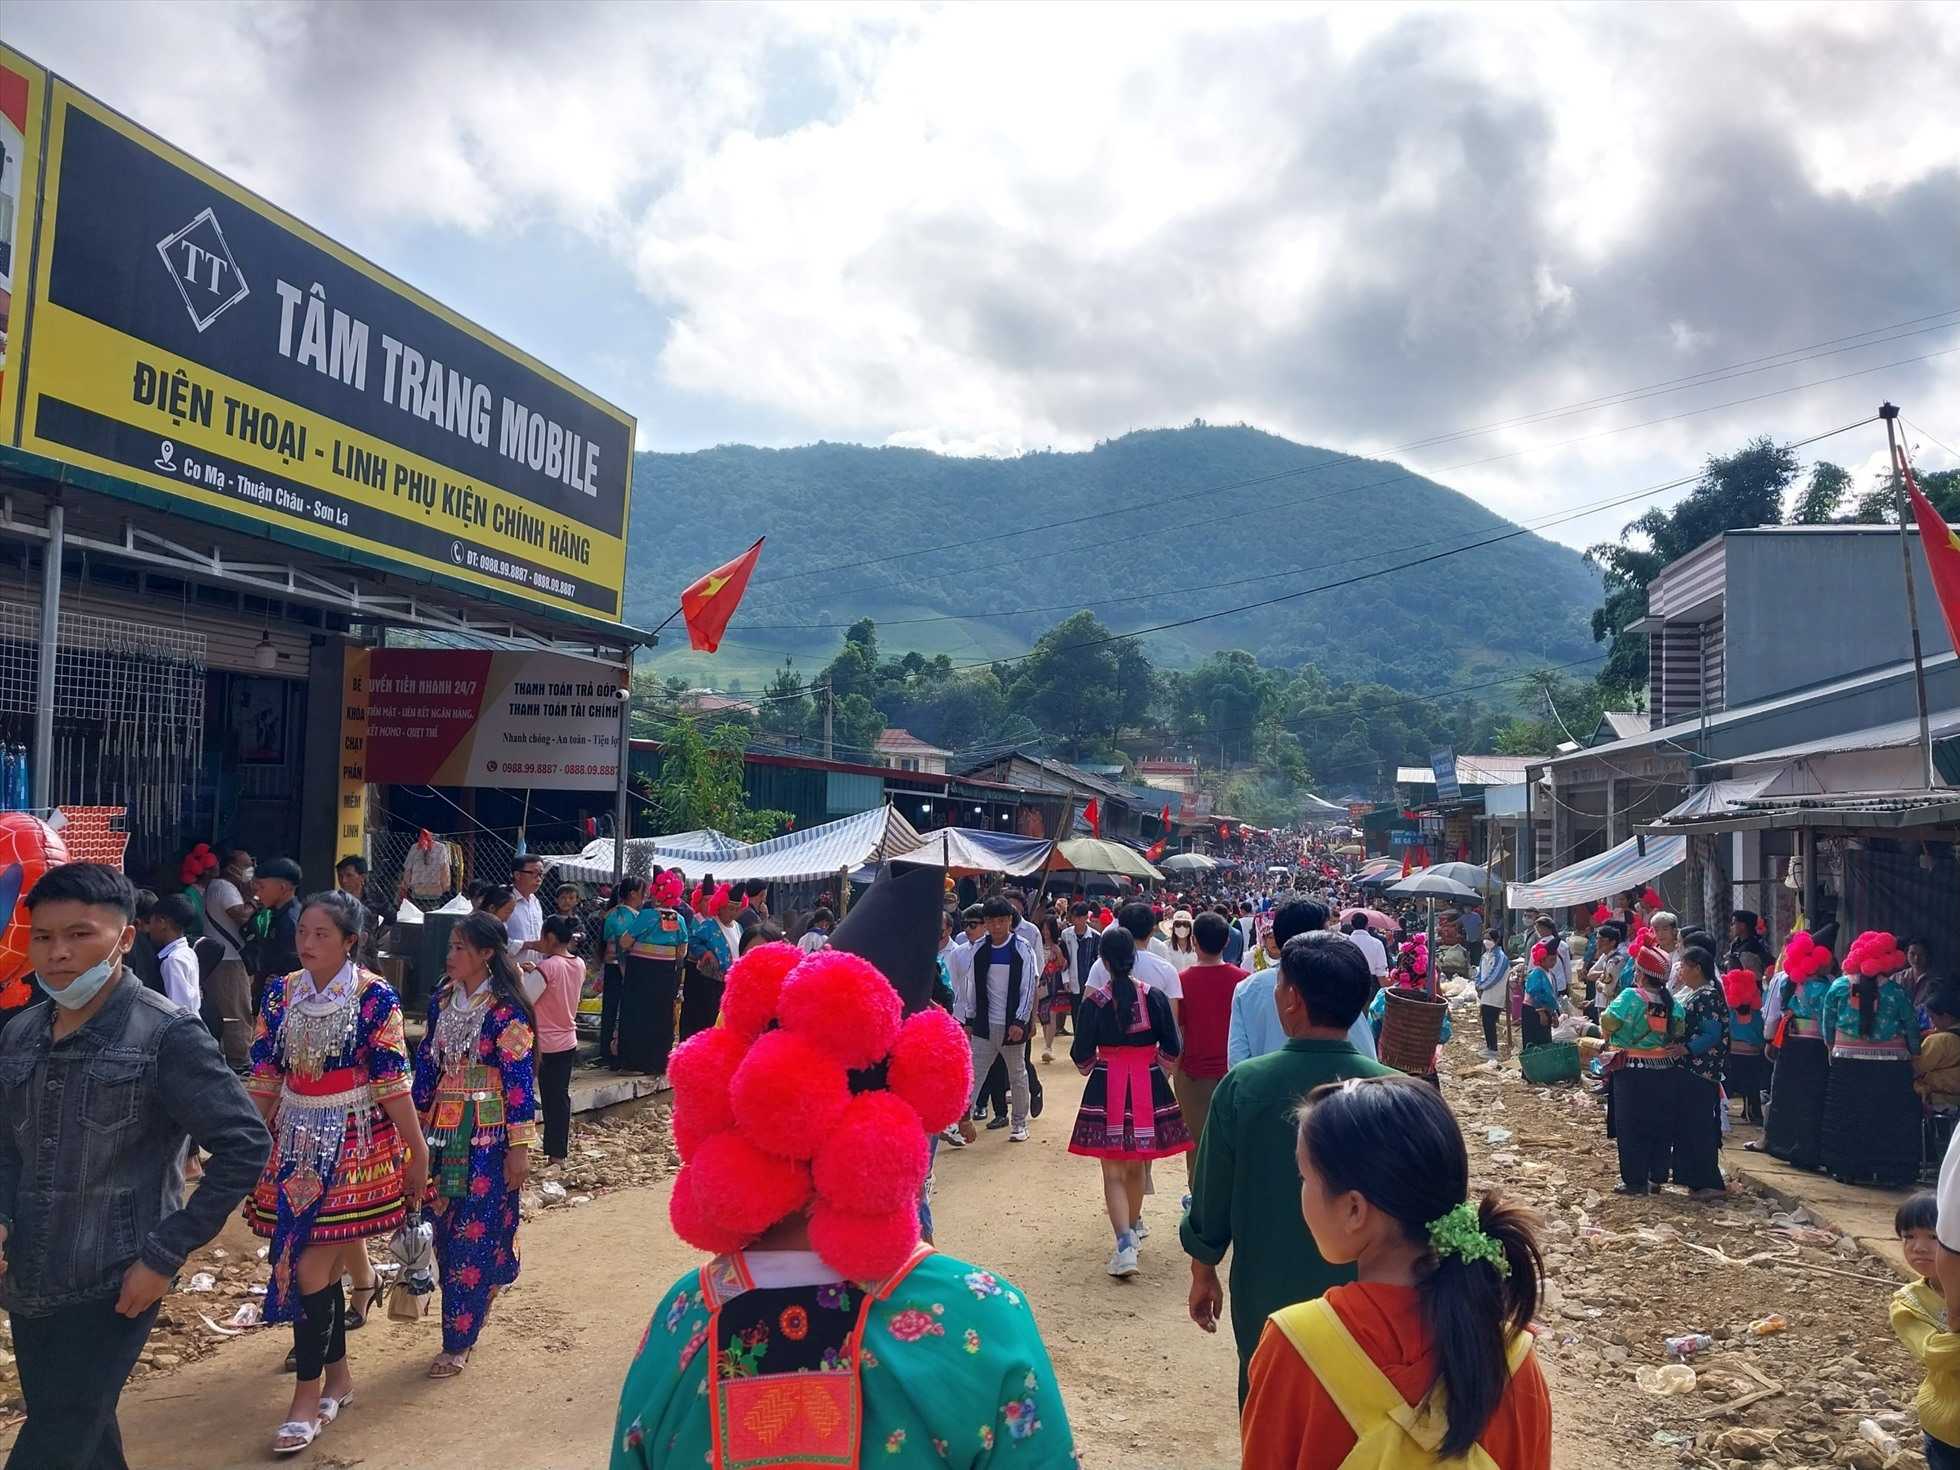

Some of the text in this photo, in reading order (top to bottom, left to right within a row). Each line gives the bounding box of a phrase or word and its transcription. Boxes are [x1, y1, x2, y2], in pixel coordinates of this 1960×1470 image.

[182, 239, 228, 295] TT
[276, 278, 600, 498] TÂM TRANG MOBILE
[133, 360, 591, 566] ĐIỆN THOẠI - LINH PHỤ KIỆN CHÍNH HÃNG
[183, 457, 201, 480] Co
[204, 464, 225, 491] Mạ
[237, 474, 273, 504] Thuận
[275, 487, 304, 512] Châu
[313, 500, 334, 522] Sơn
[336, 508, 349, 527] La
[480, 554, 528, 583] 0988.99.8887
[368, 673, 393, 693] UYỂN
[418, 679, 452, 695] NHANH
[454, 680, 477, 696] 24/7
[514, 681, 617, 698] THANH TOÁN TRẢ GÓP
[509, 702, 619, 719] THANH TOÁN TÀI CHÍNH
[503, 732, 527, 744] Nhanh
[610, 735, 620, 748] lợ
